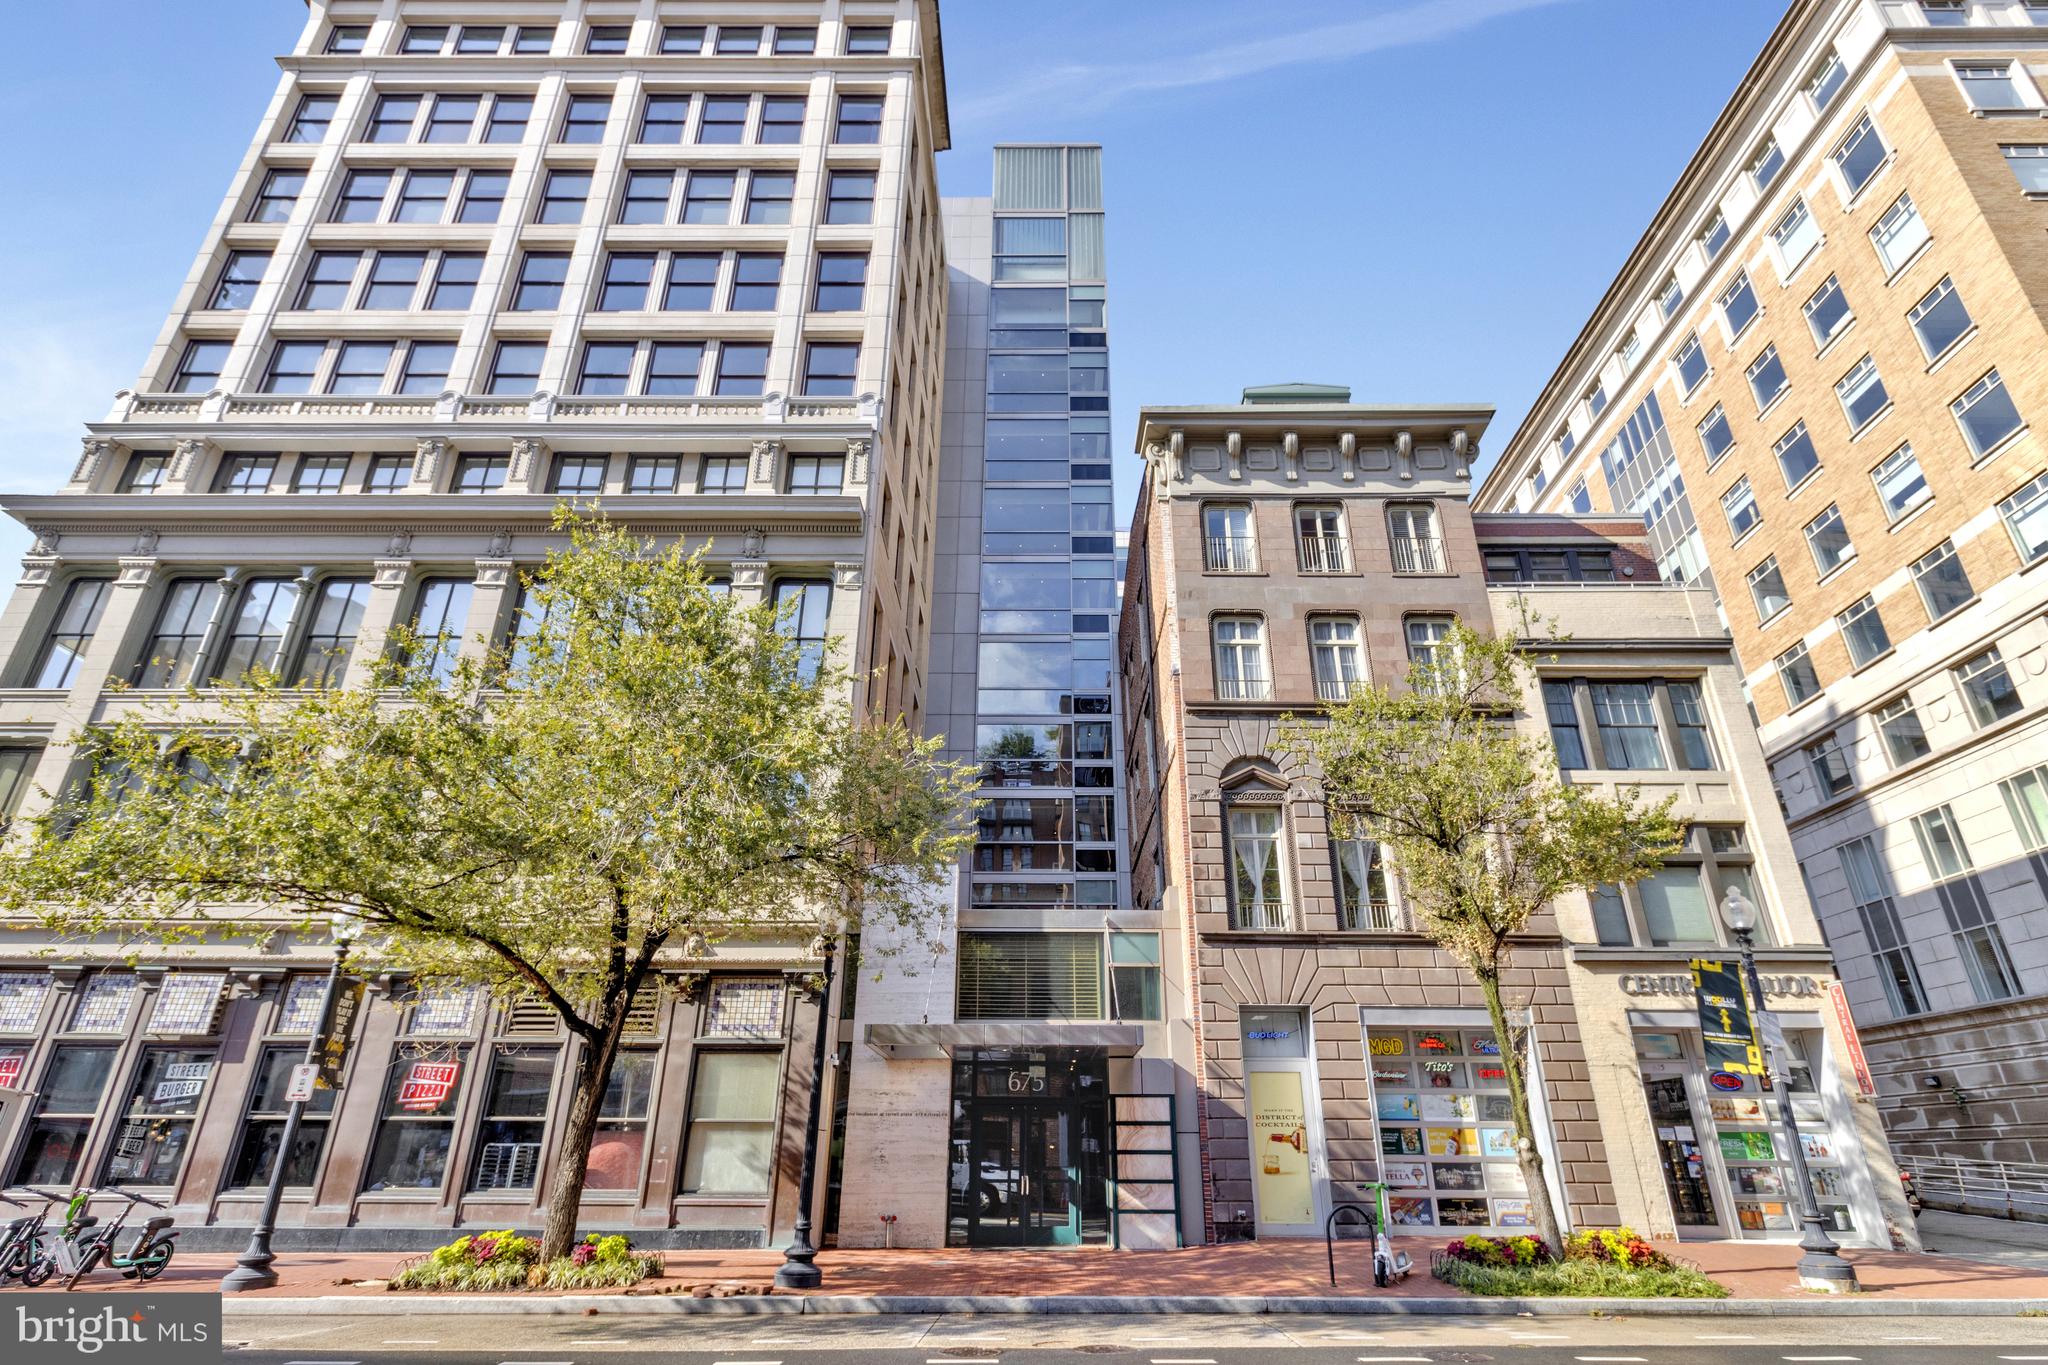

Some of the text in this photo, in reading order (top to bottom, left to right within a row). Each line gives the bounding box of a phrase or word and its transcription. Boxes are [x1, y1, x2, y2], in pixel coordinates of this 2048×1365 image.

[1618, 974, 1695, 995] CENTR
[1368, 1038, 1404, 1056] MGD
[171, 1065, 208, 1077] STREET
[1424, 1061, 1454, 1072] Tito's
[415, 1067, 450, 1081] STREET
[1008, 1071, 1044, 1092] 675
[1711, 1076, 1742, 1088] OPEN
[160, 1082, 198, 1097] BURGER
[407, 1084, 441, 1098] PIZZA
[1385, 1173, 1410, 1181] TELLA
